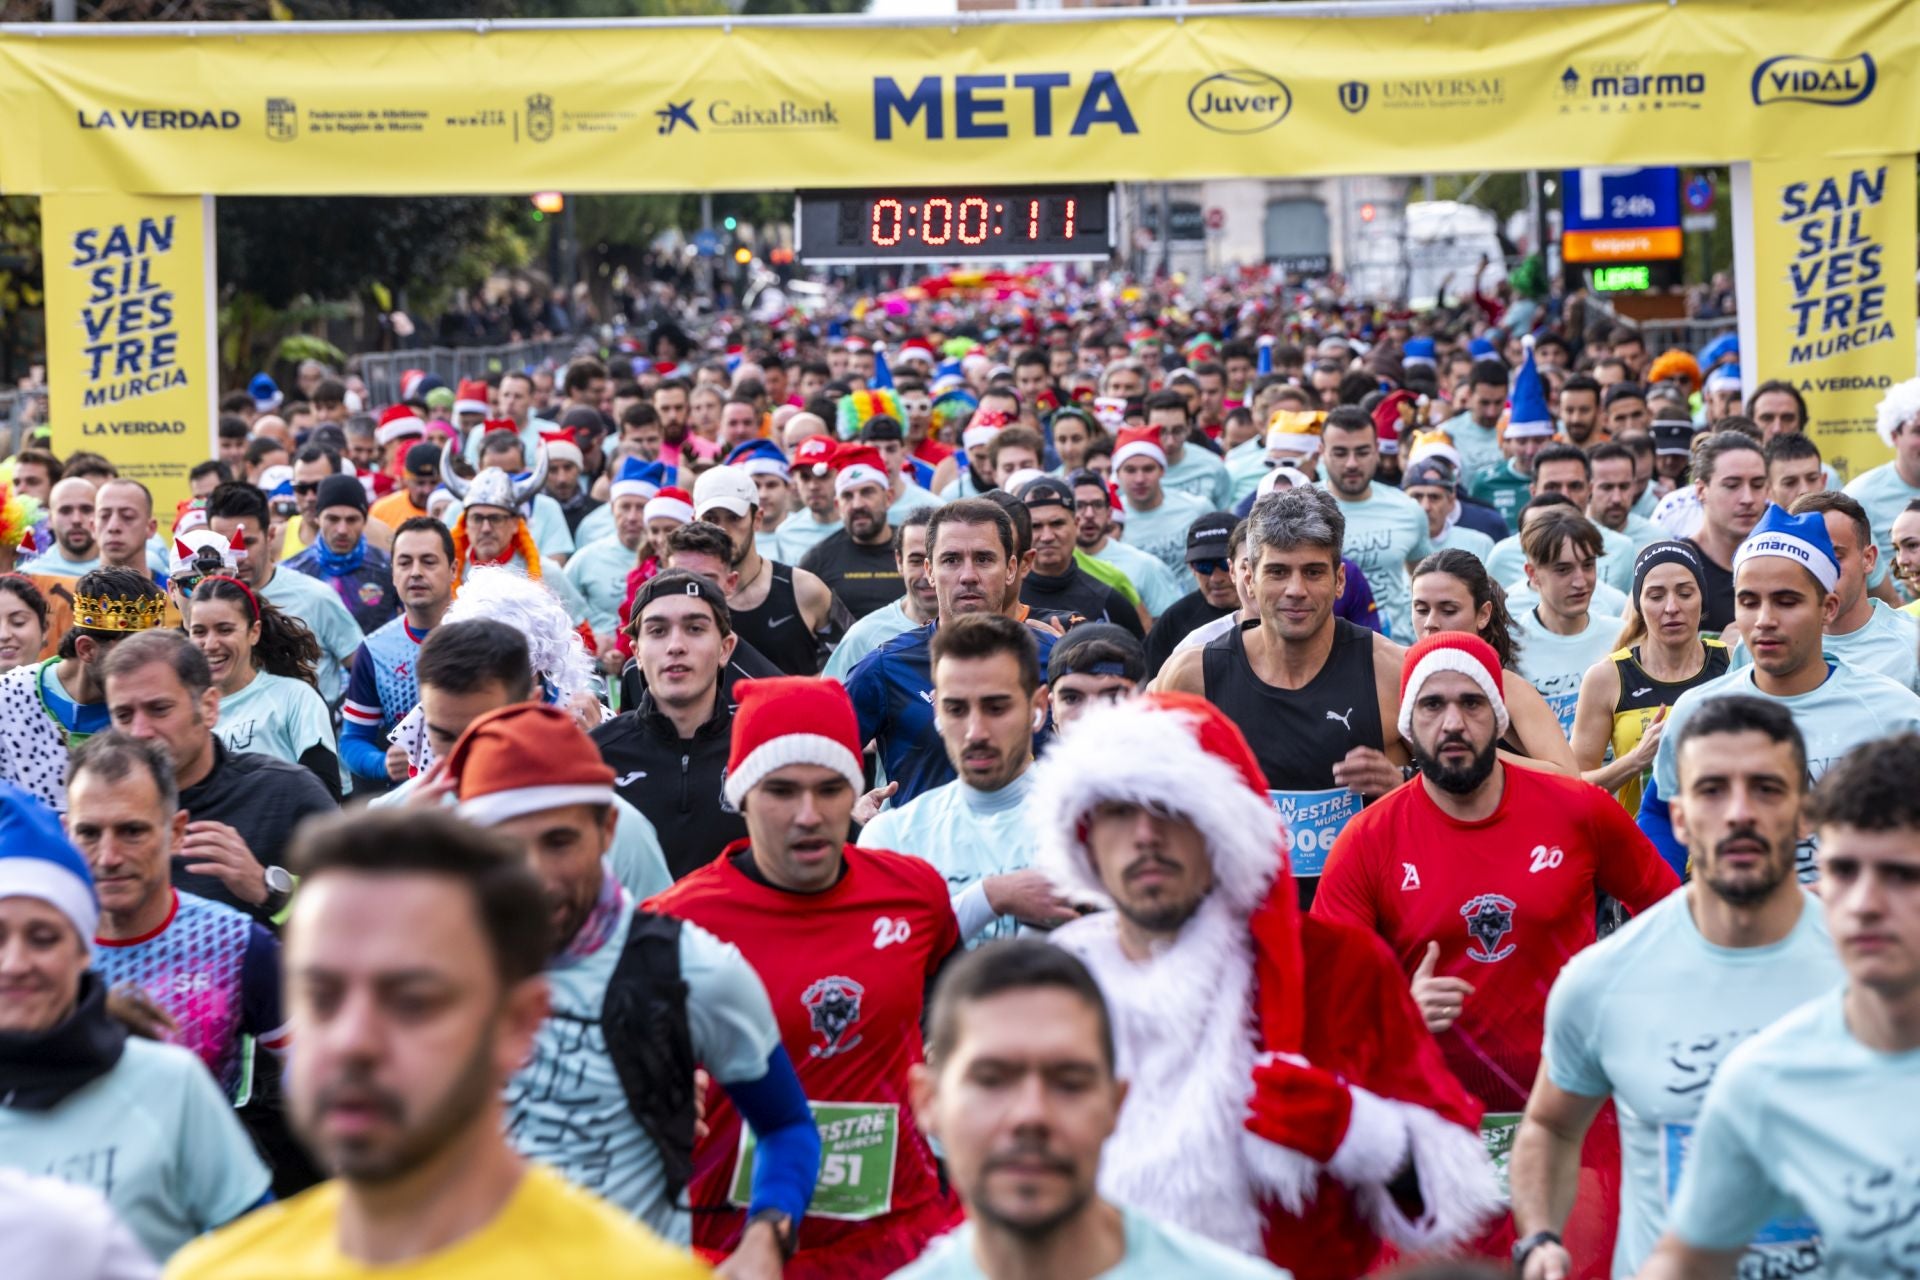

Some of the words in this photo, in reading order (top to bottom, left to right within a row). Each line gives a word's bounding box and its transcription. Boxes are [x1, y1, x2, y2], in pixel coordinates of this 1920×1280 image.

[1592, 74, 1704, 97] marmo
[1771, 68, 1859, 92] VIDAL
[707, 99, 839, 126] CaixaBank
[872, 71, 1139, 141] META
[1200, 92, 1280, 113] Juver
[78, 111, 115, 129] LA
[122, 109, 241, 129] VERDAD
[1611, 194, 1656, 219] 24h
[1780, 166, 1887, 222] SAN
[871, 198, 1075, 245] 0:00:11
[1797, 210, 1871, 259] SIL
[71, 215, 176, 268] SAN
[88, 259, 160, 304] SIL
[1788, 244, 1883, 298] VES
[80, 292, 174, 342] VES
[1791, 285, 1886, 337] TRE
[83, 332, 179, 381] TRE
[1789, 322, 1895, 363] MURCIA
[83, 369, 188, 407] MURCIA
[1817, 376, 1891, 391] VERDAD
[83, 422, 107, 435] LA
[110, 421, 186, 435] VERDAD
[1756, 541, 1811, 561] marmo
[1284, 793, 1353, 824] VESTRE
[1315, 809, 1353, 828] MURCIA
[1529, 844, 1565, 874] 20
[873, 916, 911, 949] 20
[820, 1154, 863, 1186] 51
